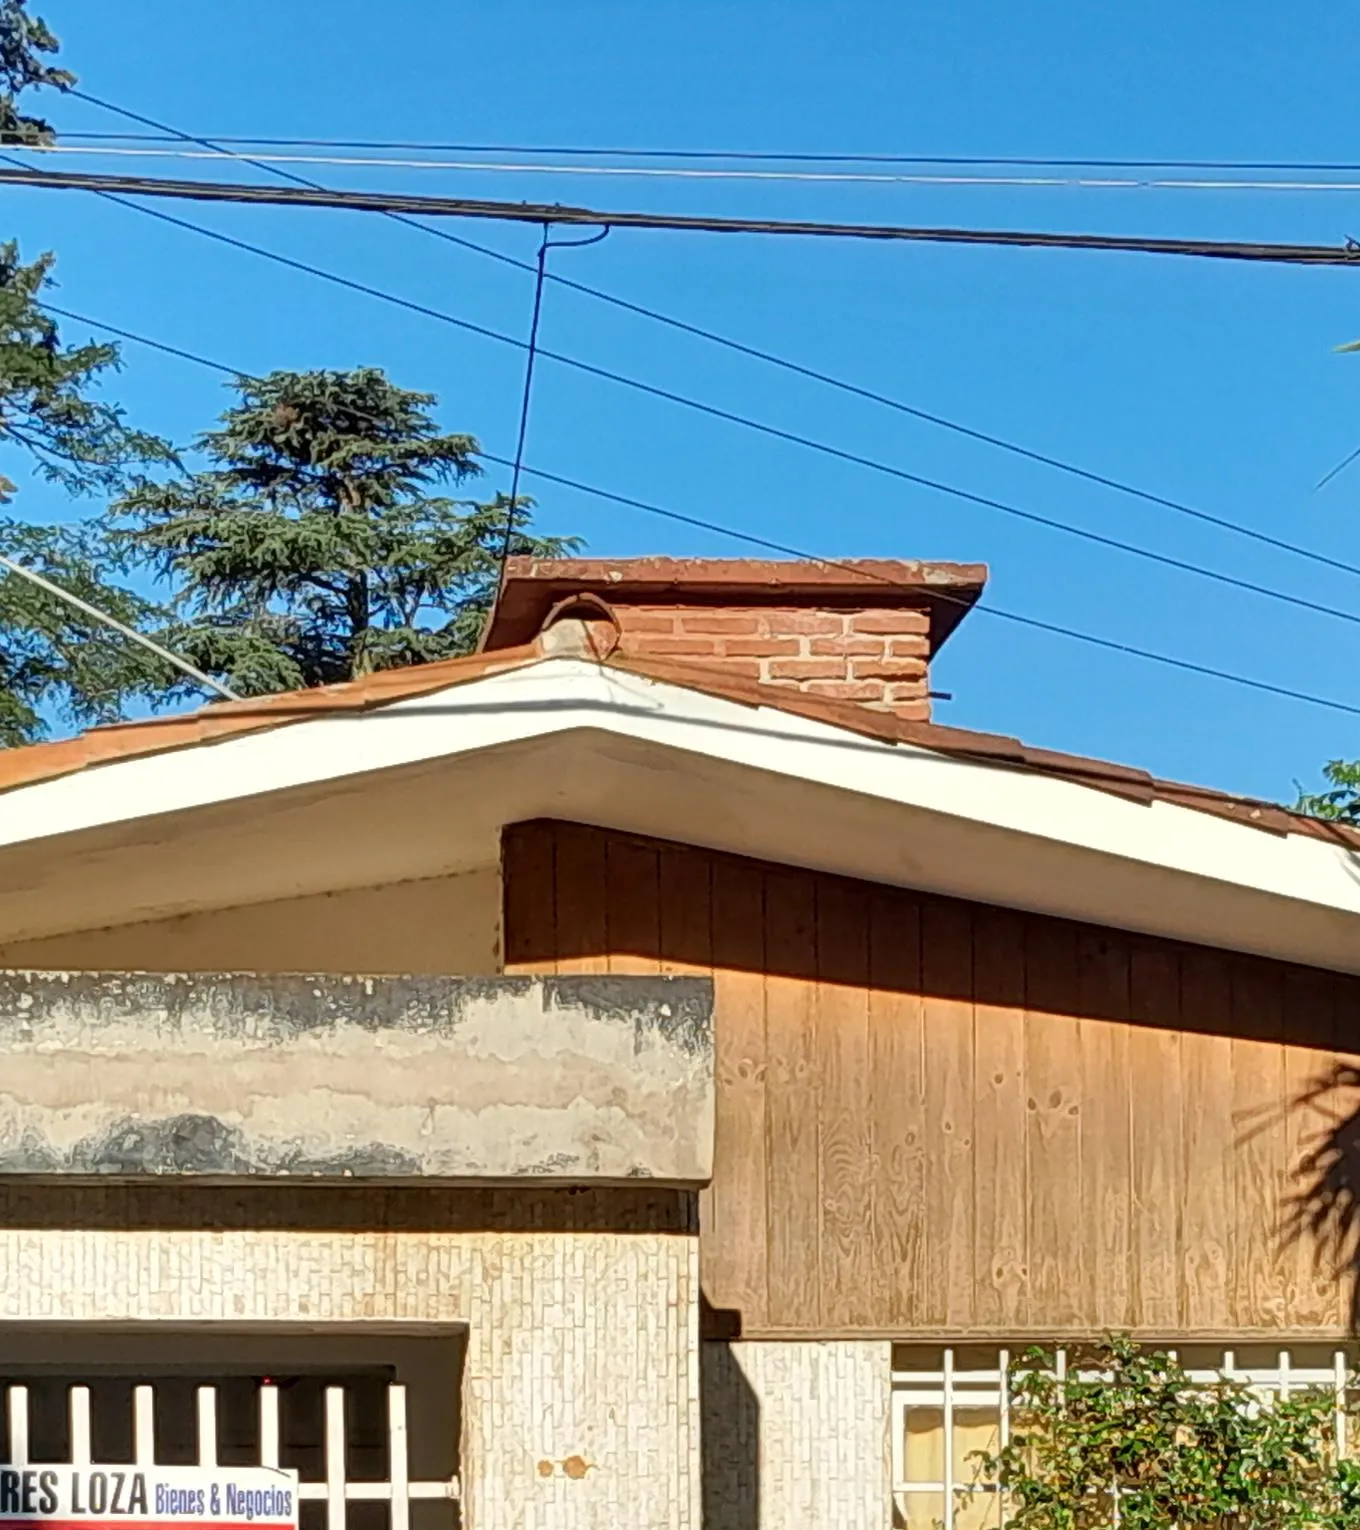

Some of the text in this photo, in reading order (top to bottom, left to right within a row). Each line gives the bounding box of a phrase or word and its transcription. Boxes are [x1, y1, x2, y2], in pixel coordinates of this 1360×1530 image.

[71, 1471, 148, 1515] LOZA
[155, 1483, 205, 1516] Bienes
[210, 1483, 221, 1516] &
[226, 1483, 292, 1520] Negocios
